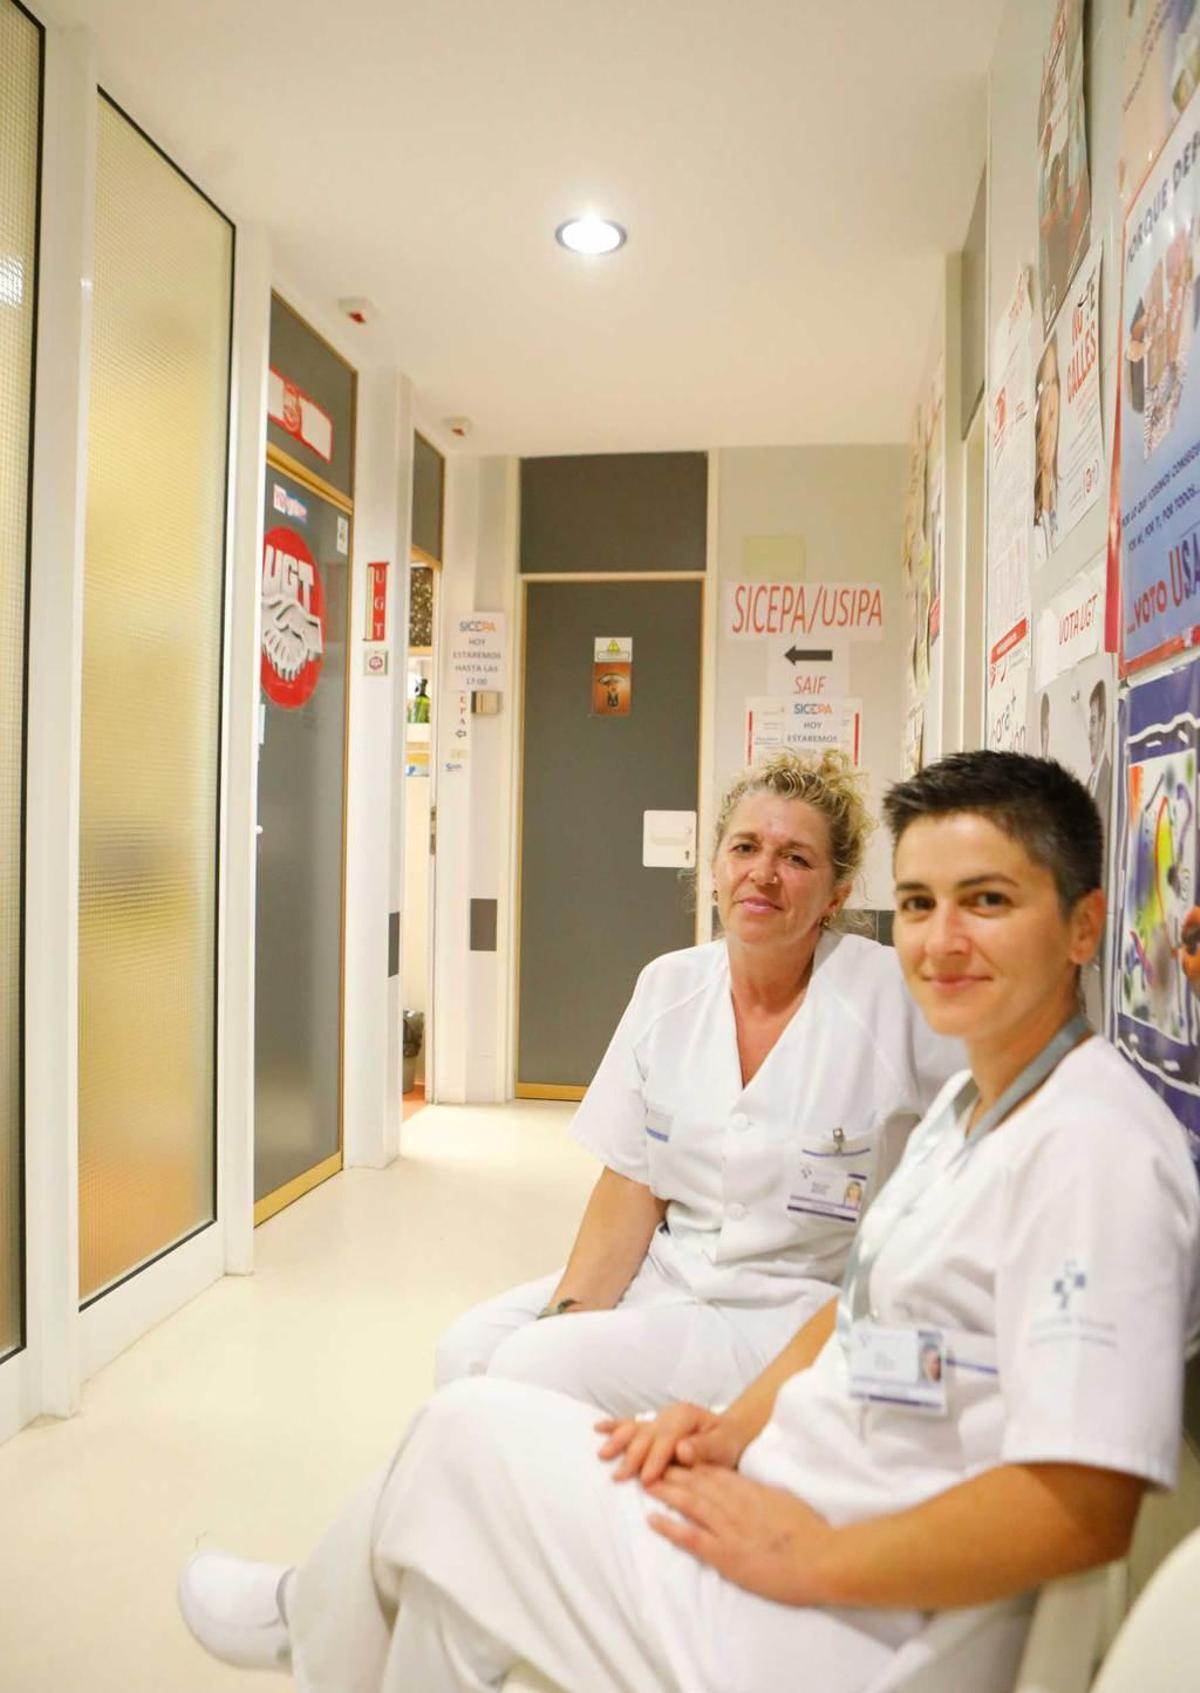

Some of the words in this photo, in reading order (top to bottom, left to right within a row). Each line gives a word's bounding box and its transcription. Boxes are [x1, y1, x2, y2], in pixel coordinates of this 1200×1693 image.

[262, 544, 315, 614] UGT
[373, 567, 386, 638] UGT
[732, 584, 882, 634] SICEPA/USIPA
[793, 675, 827, 695] SAIF
[803, 721, 823, 729] HOY
